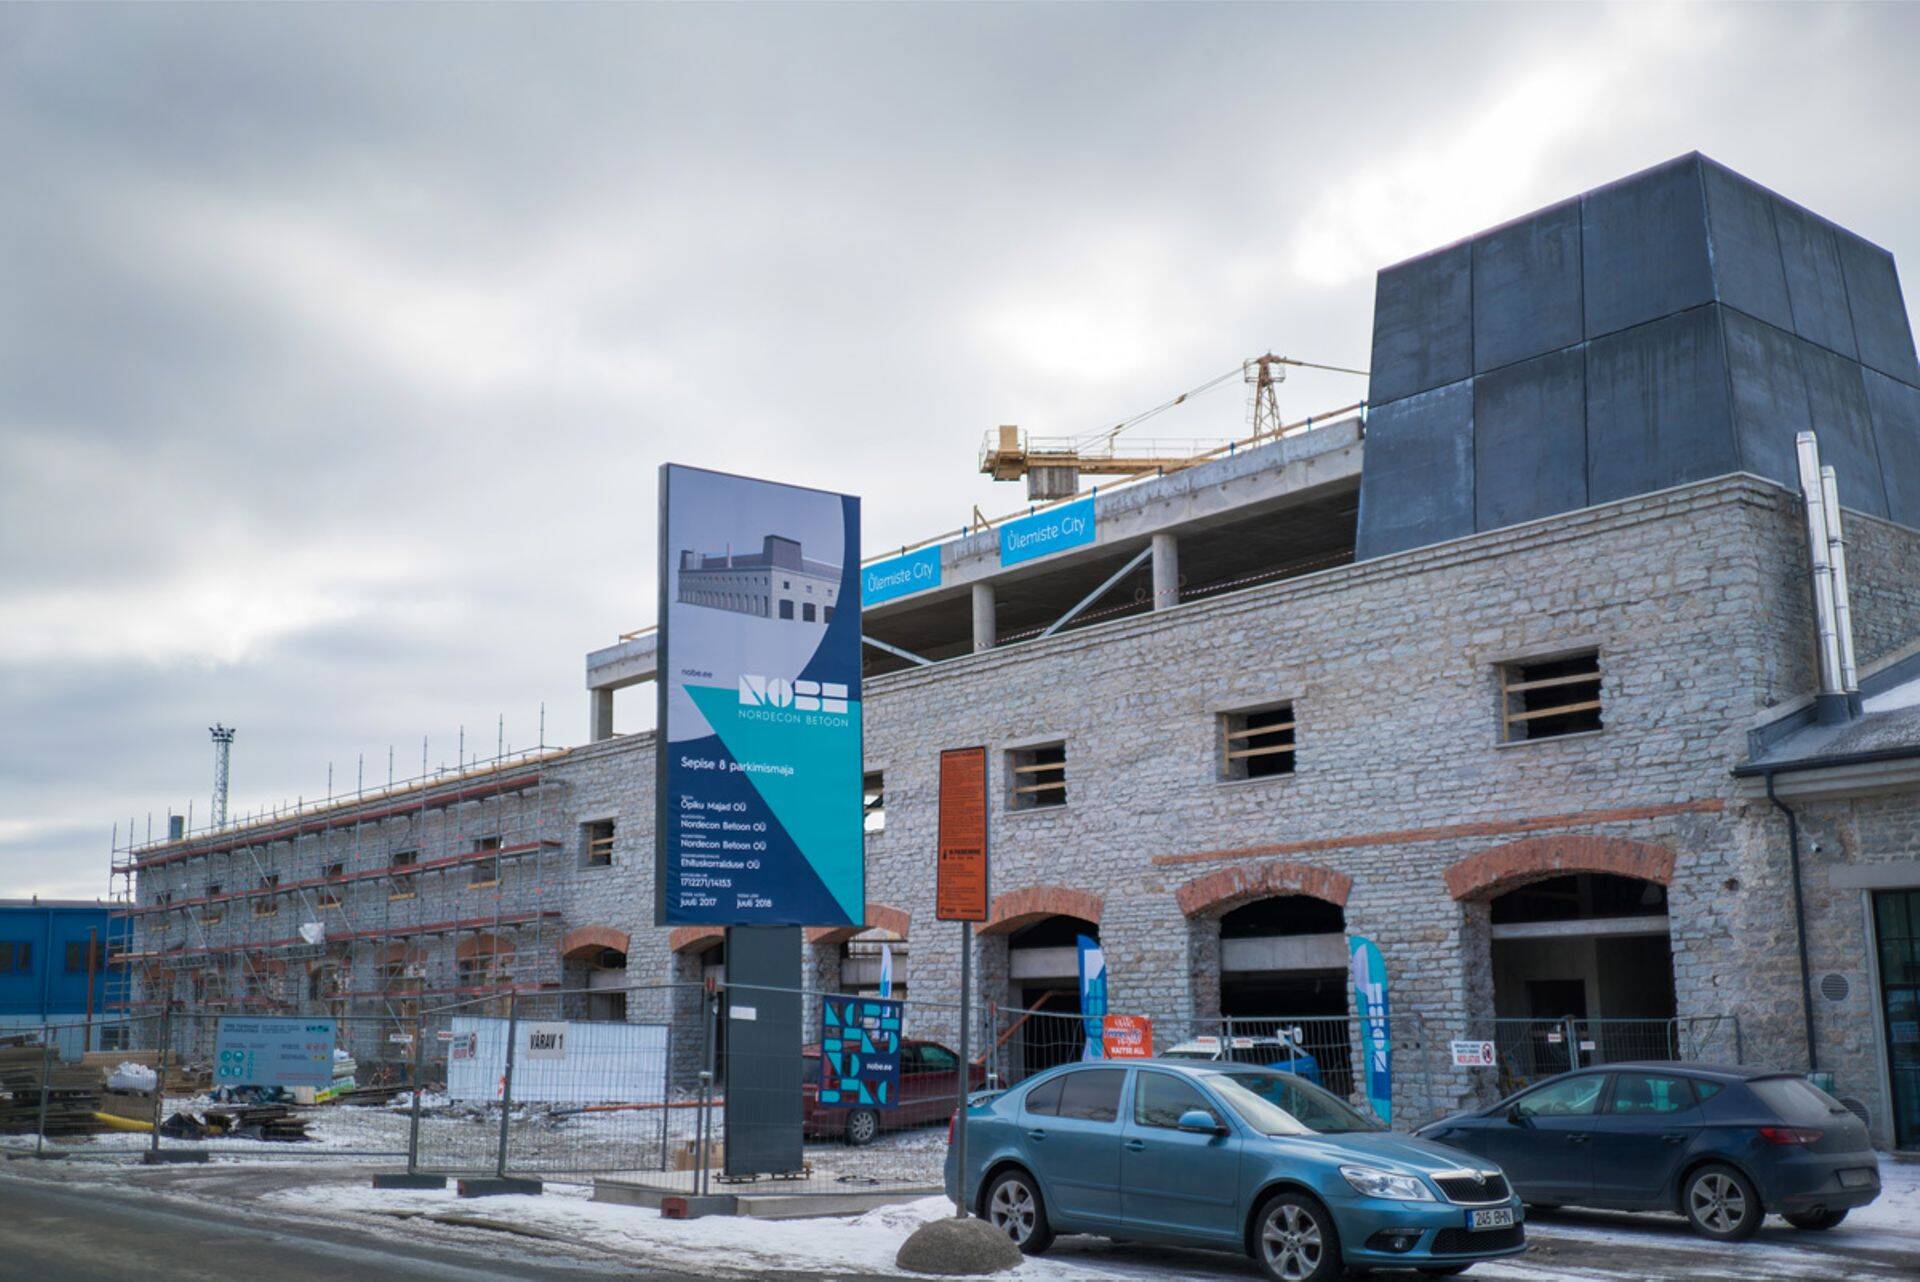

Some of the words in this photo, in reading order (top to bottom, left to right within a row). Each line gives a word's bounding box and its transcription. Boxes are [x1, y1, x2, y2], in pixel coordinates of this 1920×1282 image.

[1007, 524, 1058, 551] Ülemiste
[1061, 516, 1086, 536] City
[867, 570, 912, 592] Ülemiste
[913, 561, 934, 578] City
[681, 668, 713, 679] nobe.ee
[738, 674, 849, 715] NOBE
[738, 710, 801, 723] NORDECON
[805, 716, 849, 727] BETOON
[680, 756, 716, 771] Sepise
[718, 759, 727, 770] 8
[729, 761, 795, 776] parkimismaja
[706, 802, 732, 813] Majad
[732, 801, 747, 812] OÜ
[680, 820, 721, 830] Nordecon
[722, 822, 751, 831] Betoon
[752, 821, 767, 832] OÜ
[680, 839, 721, 849] Nordecon
[722, 841, 751, 850] Betoon
[752, 840, 767, 851] OÜ
[746, 859, 760, 869] OÜ
[699, 898, 718, 906] 2017
[529, 1030, 556, 1050] VÄRAV
[558, 1034, 564, 1050] 1
[866, 1062, 893, 1072] nobe.ee
[1475, 1211, 1492, 1226] 245
